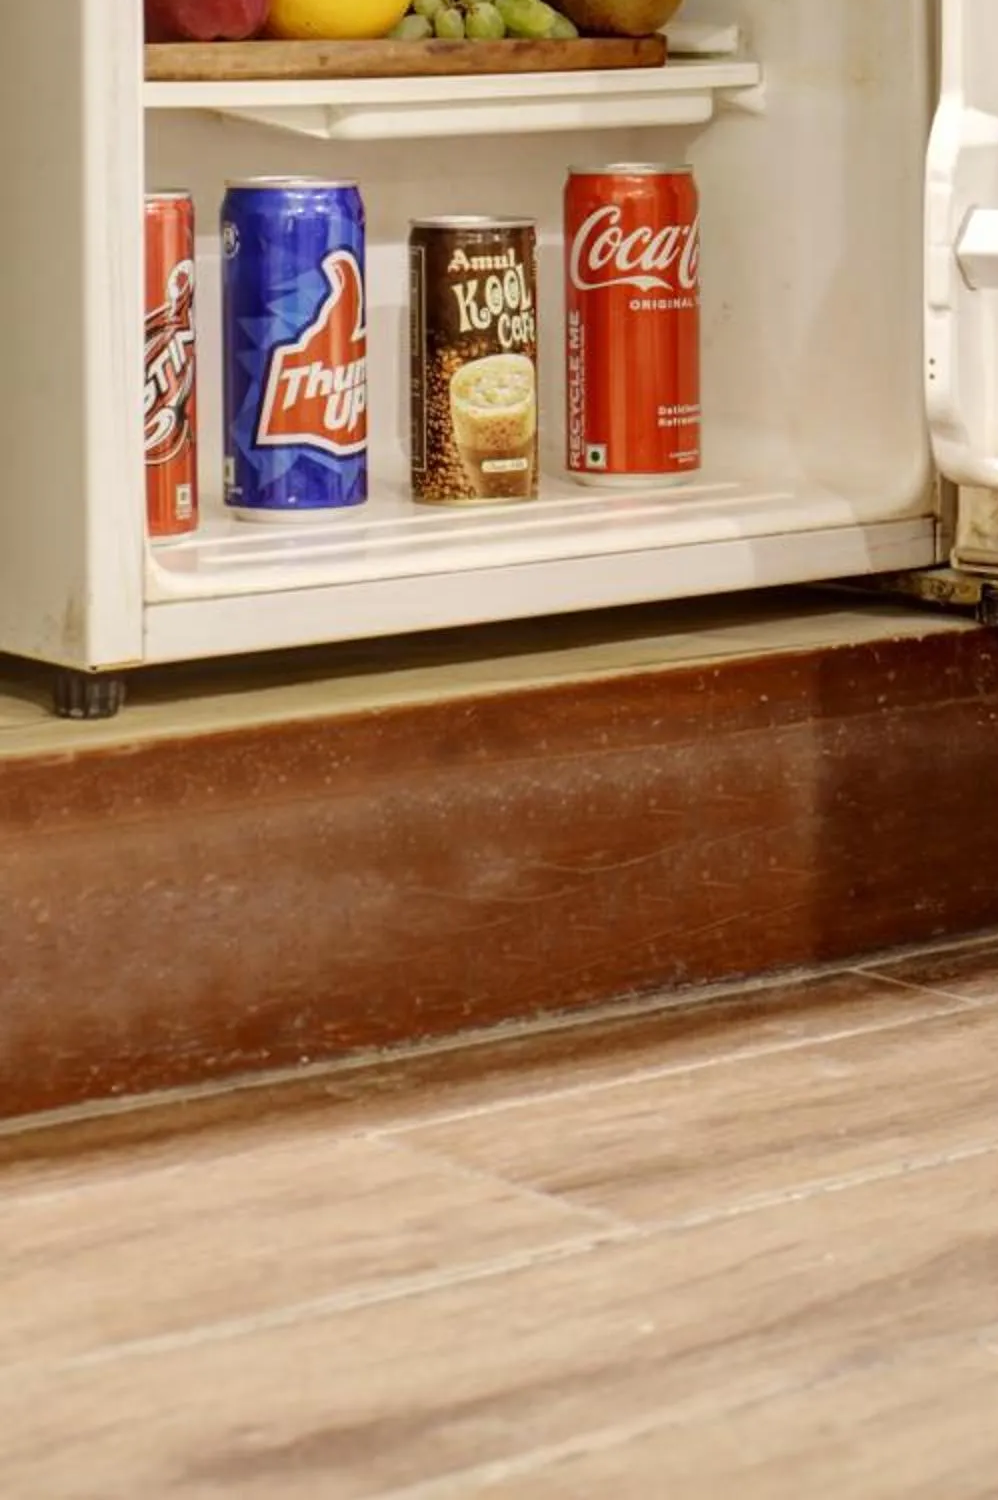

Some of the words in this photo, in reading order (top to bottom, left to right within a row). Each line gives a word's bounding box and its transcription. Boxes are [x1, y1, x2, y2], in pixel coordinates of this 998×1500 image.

[447, 247, 515, 273] Amul
[569, 309, 580, 349] ME
[569, 355, 581, 469] RECYCLE
